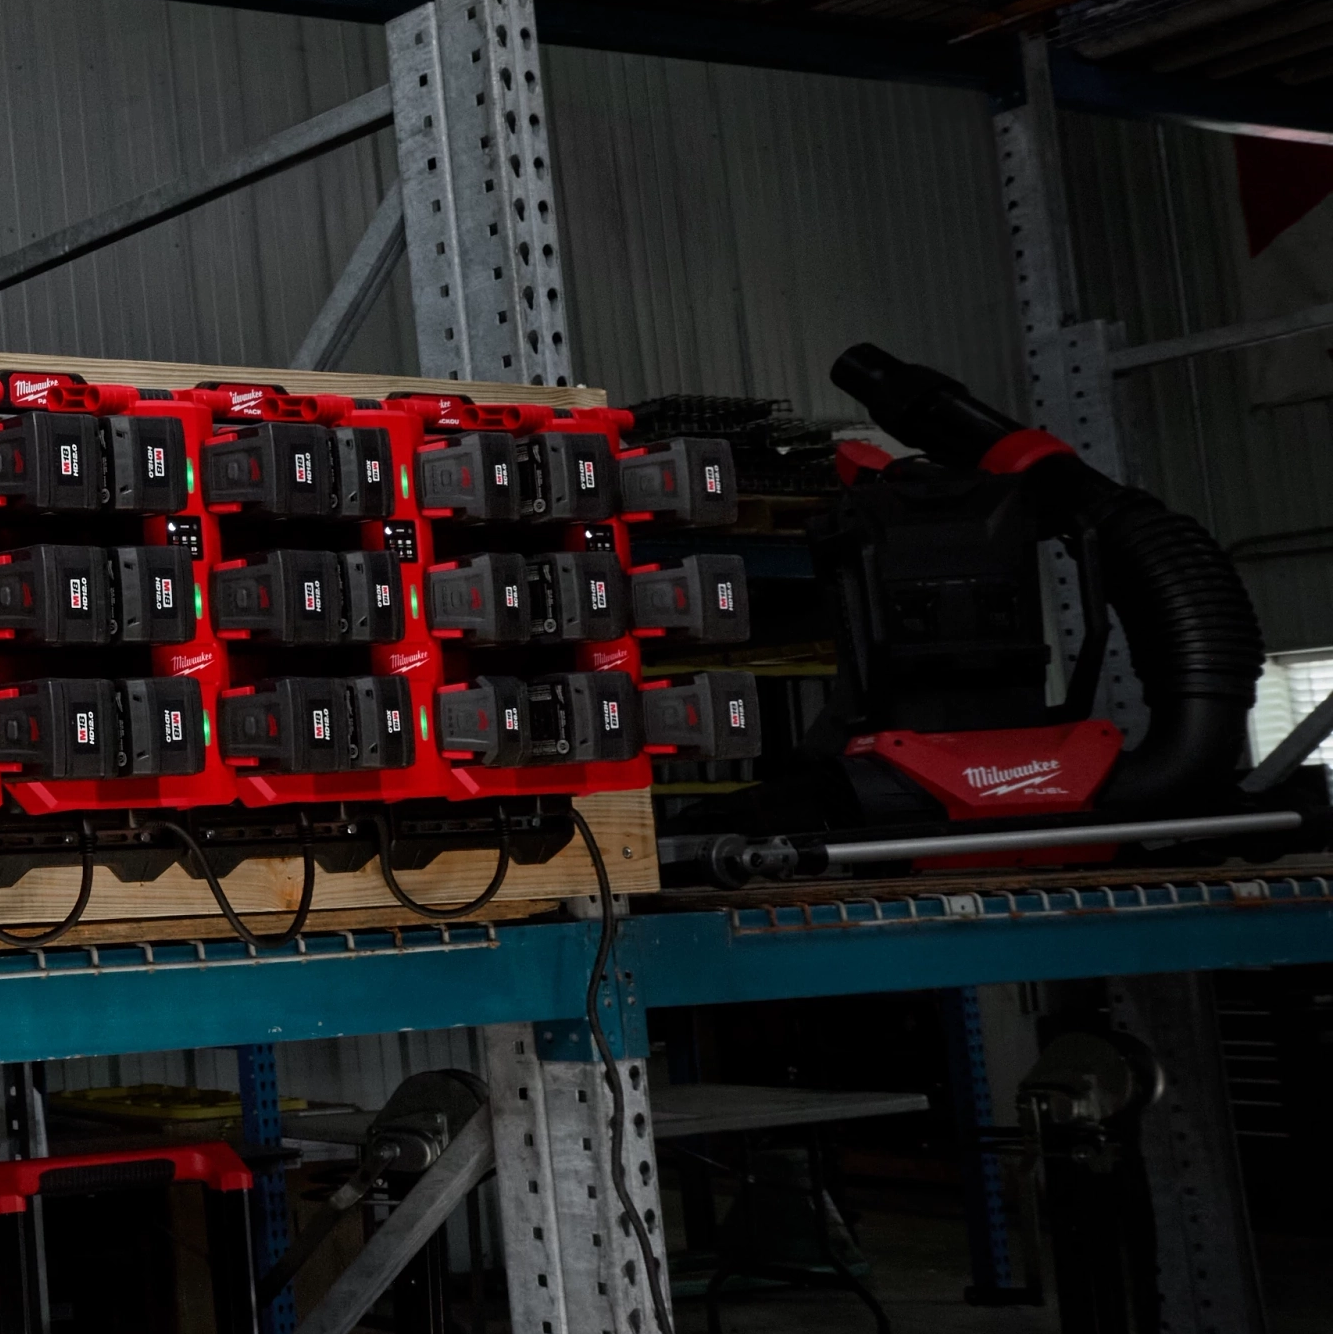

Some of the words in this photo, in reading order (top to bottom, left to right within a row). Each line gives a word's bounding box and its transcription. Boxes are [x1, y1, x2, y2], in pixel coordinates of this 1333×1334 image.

[14, 378, 59, 396] Milwaukee
[62, 447, 71, 473] M18
[155, 449, 163, 475] M18
[296, 455, 304, 481] M18
[71, 580, 80, 607] M18
[163, 580, 171, 606] M18
[306, 583, 314, 609] M18
[170, 652, 213, 671] Milwaukee
[389, 650, 428, 668] Milwaukee
[592, 649, 628, 667] Milwaukee
[78, 715, 87, 742] M18
[172, 712, 181, 739] M18
[314, 712, 323, 737] M18
[961, 759, 1061, 788] Milwaukee
[1023, 787, 1069, 795] FUEL
